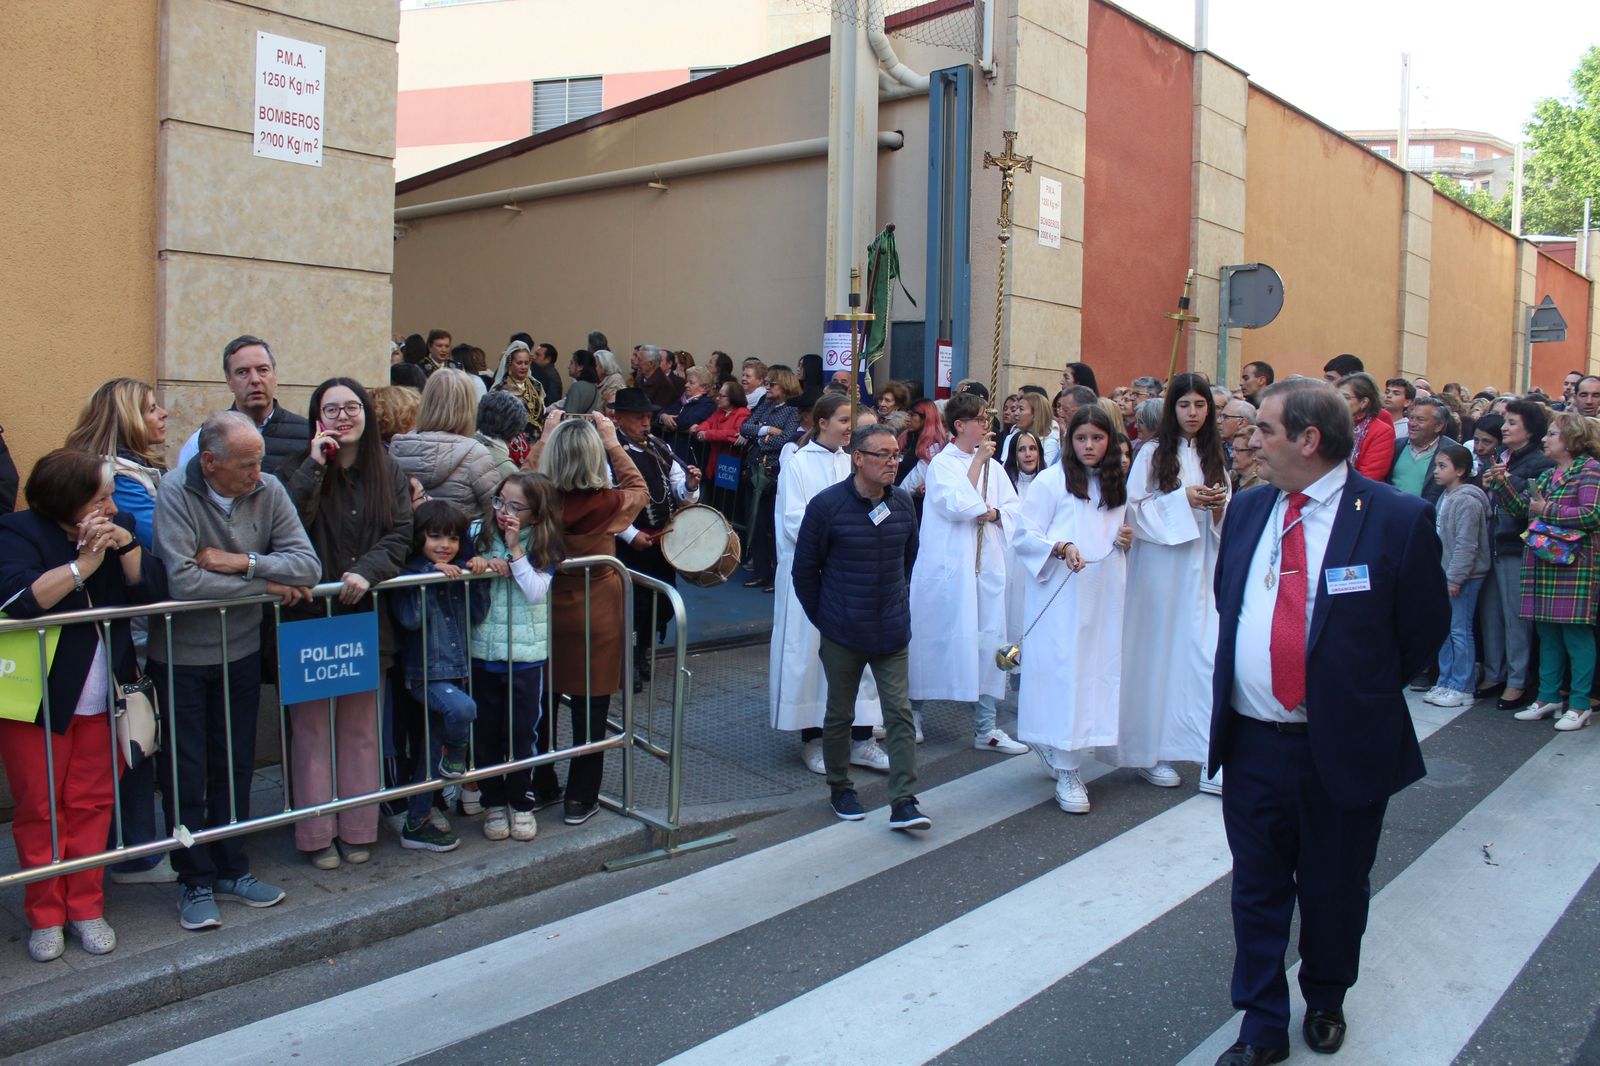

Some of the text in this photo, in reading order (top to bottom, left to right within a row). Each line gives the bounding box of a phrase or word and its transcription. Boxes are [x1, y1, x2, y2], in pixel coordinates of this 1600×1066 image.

[276, 49, 307, 69] P.M.A.
[262, 71, 286, 89] 1250
[259, 106, 320, 131] BOMBEROS
[260, 131, 284, 149] 2000
[301, 642, 364, 664] POLICIA
[304, 662, 360, 682] LOCAL
